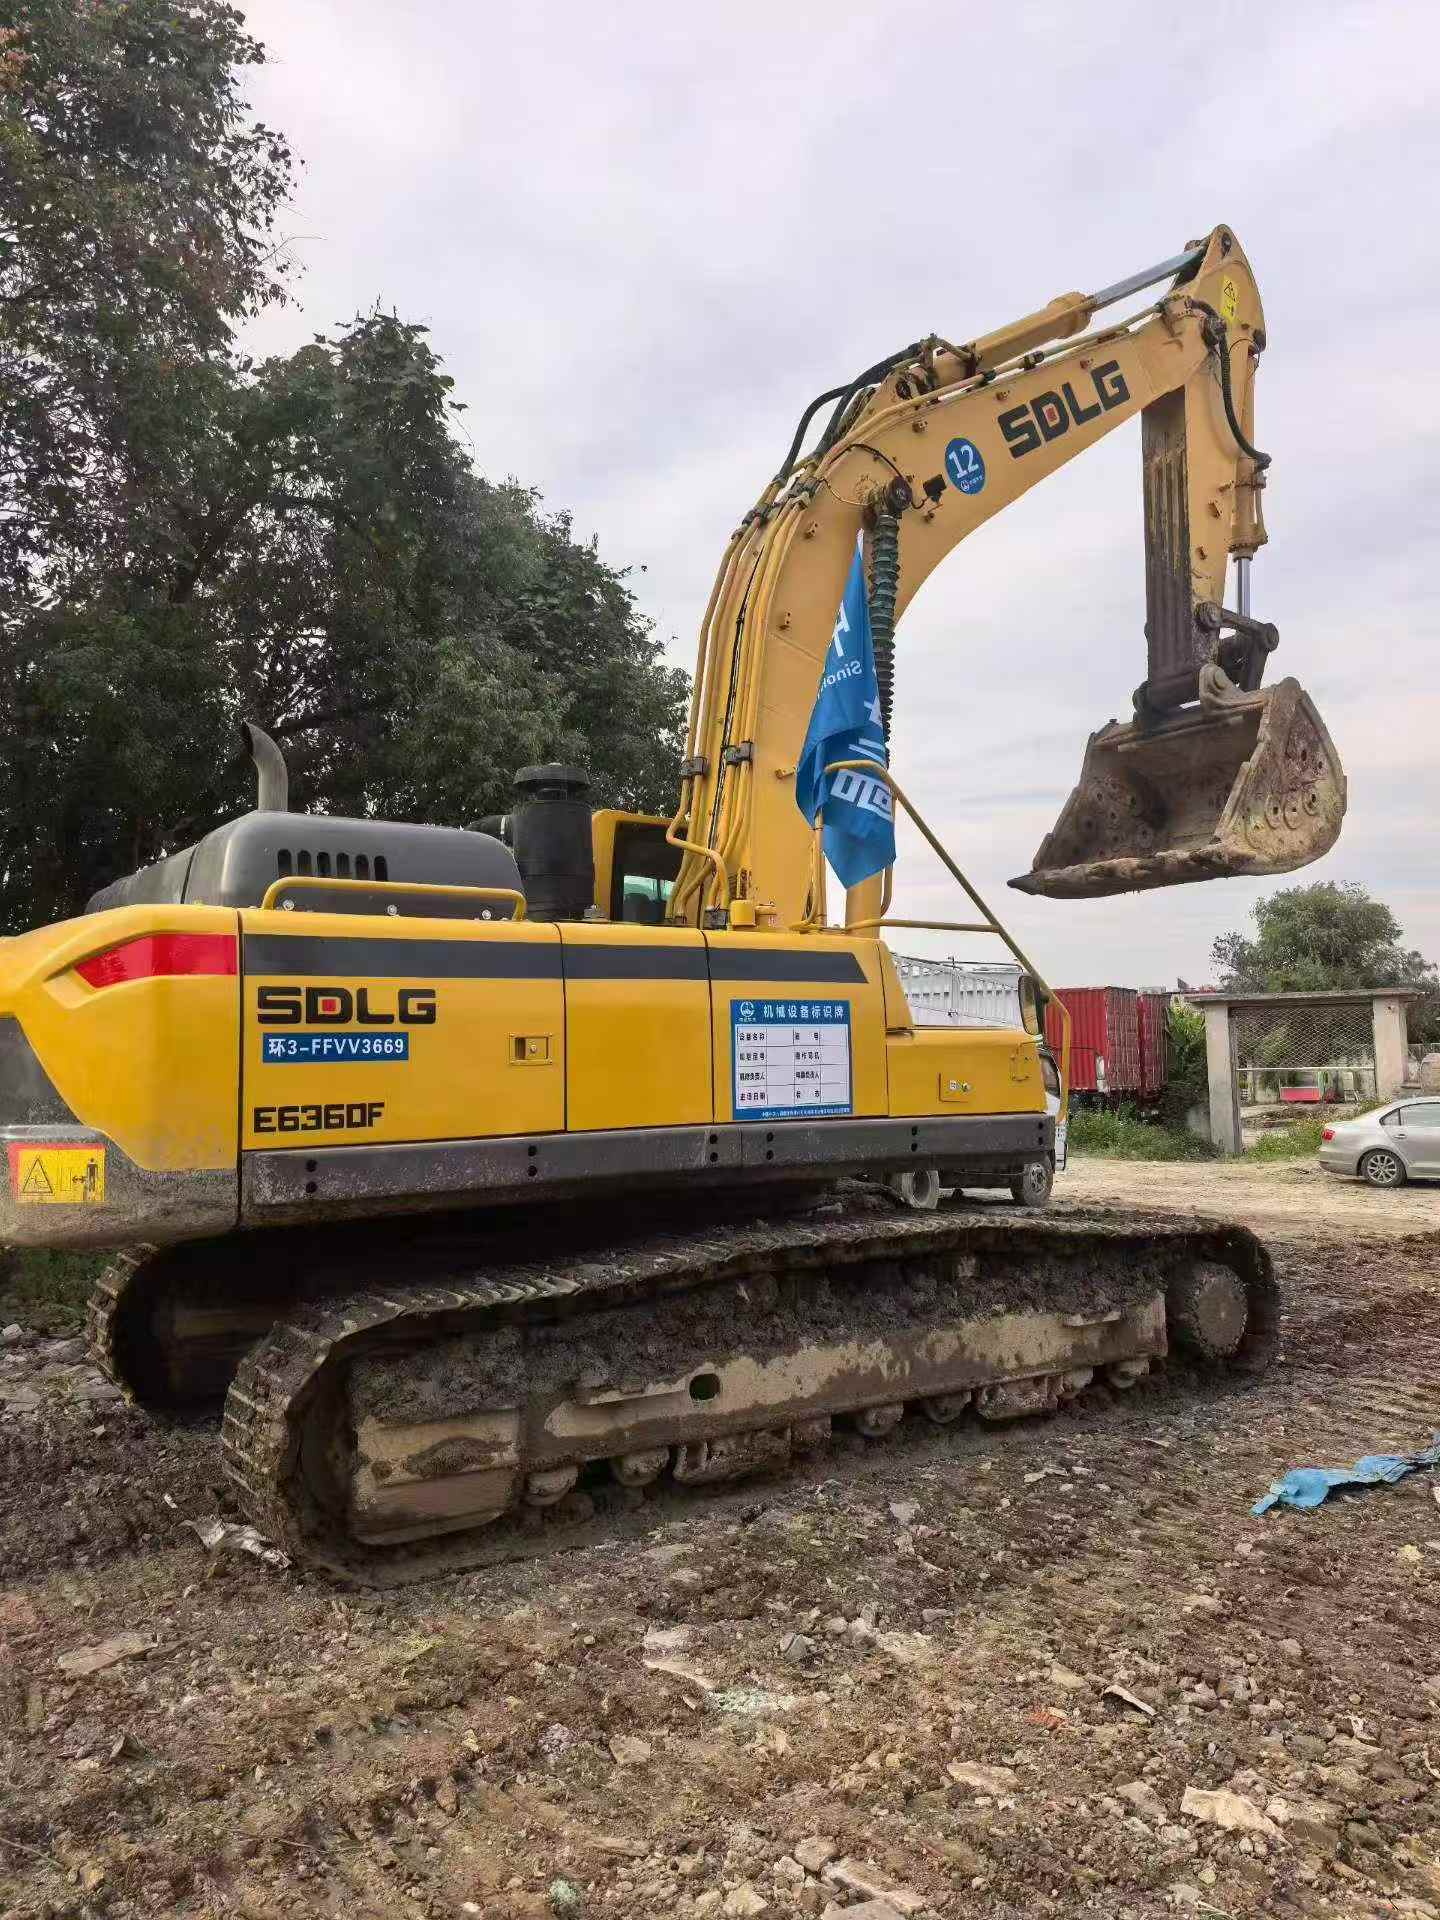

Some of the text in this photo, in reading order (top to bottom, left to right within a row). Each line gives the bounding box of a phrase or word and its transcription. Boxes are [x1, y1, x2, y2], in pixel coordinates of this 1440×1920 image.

[997, 359, 1131, 460] SDLG
[949, 444, 980, 479] 12
[257, 985, 437, 1025] SDLG
[763, 1004, 844, 1018] 机械设备标识牌
[268, 1037, 404, 1057] 环3-FFVV3669
[253, 1101, 385, 1133] E6360F
